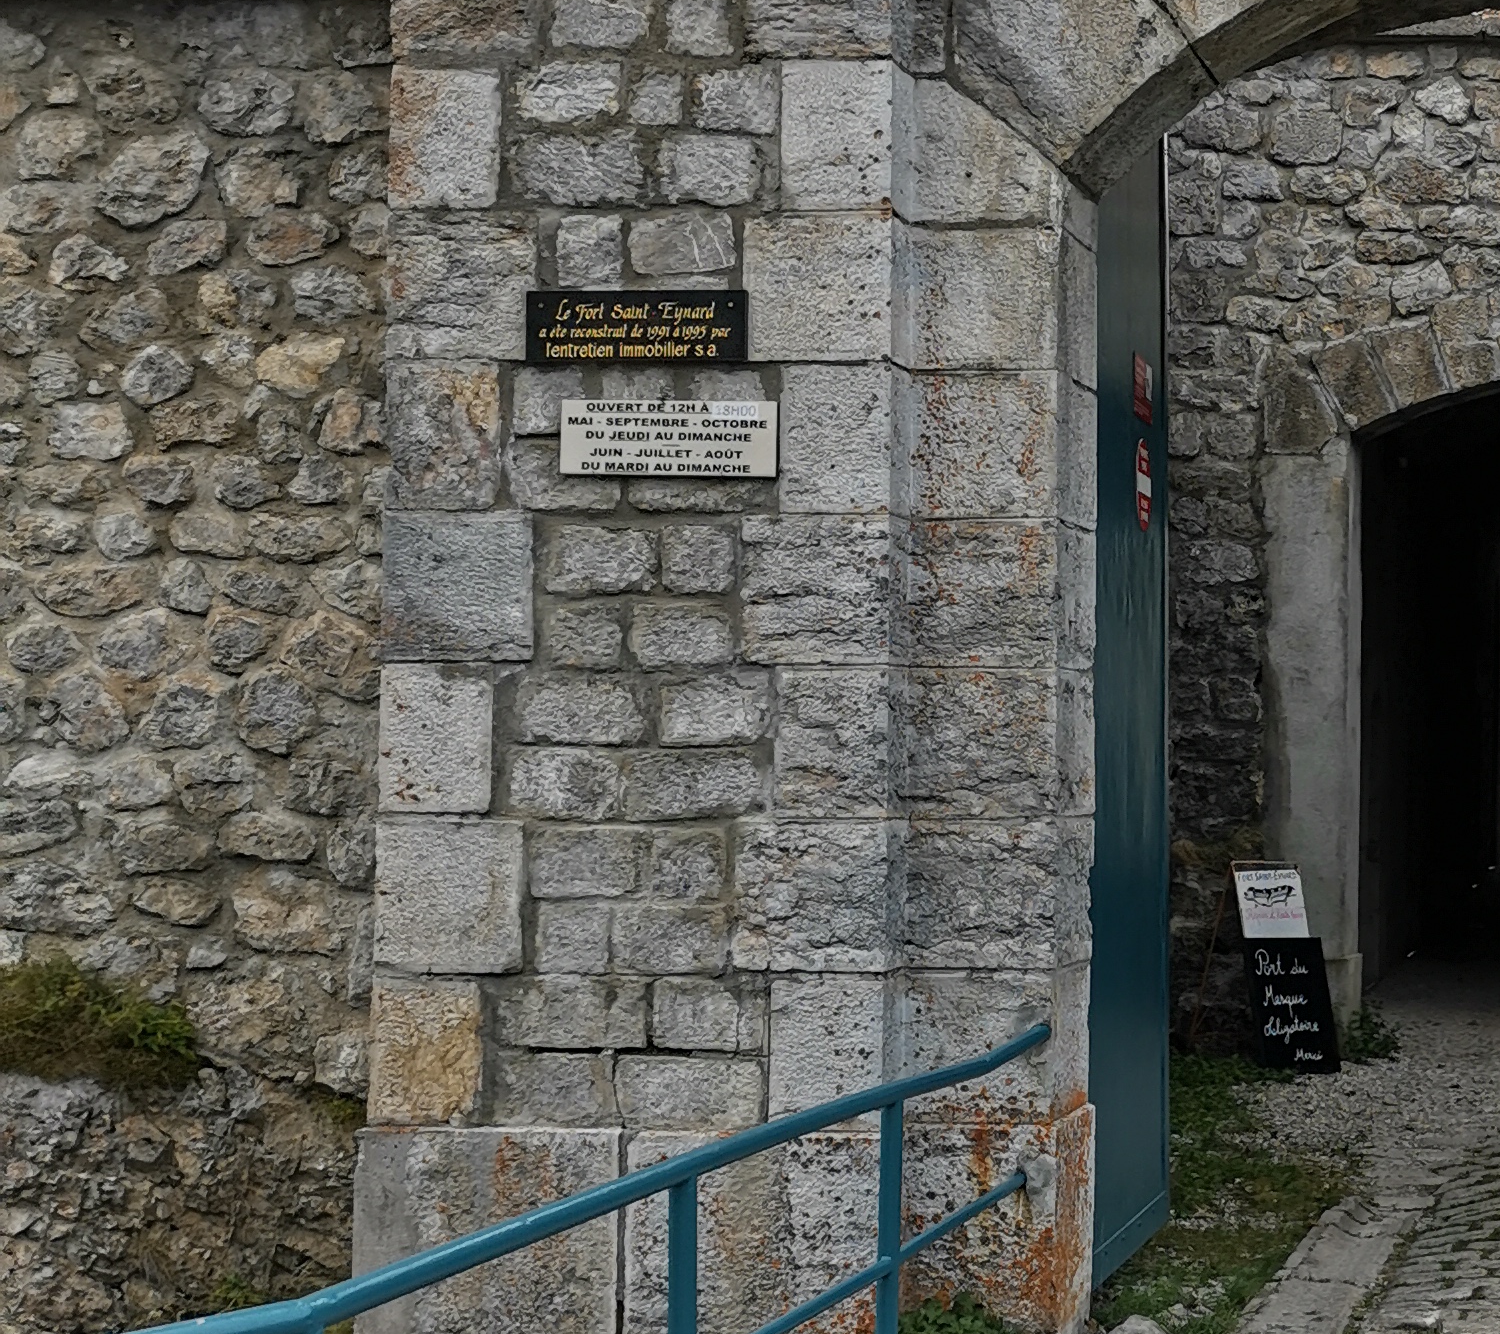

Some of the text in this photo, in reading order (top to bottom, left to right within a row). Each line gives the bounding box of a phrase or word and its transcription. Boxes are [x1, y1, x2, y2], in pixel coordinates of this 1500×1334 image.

[555, 299, 572, 321] Le
[575, 302, 604, 325] Fort
[538, 326, 547, 338] a
[570, 324, 628, 339] reconstruit
[630, 323, 643, 338] de
[647, 326, 670, 341] 1991
[682, 325, 707, 341] 1995
[711, 327, 732, 340] par
[619, 341, 690, 359] immobilier
[586, 402, 643, 413] OUVERT
[648, 402, 665, 413] DE
[671, 402, 696, 413] 12H
[567, 417, 593, 426] MAI
[606, 417, 689, 427] SEPTEMBRE
[701, 419, 768, 429] OCTOBRE
[585, 430, 752, 442] DU JEUDI AU DIMANCHE
[589, 447, 623, 457] JUIN
[634, 448, 693, 458] JUILLET
[704, 447, 743, 459] AOÛT
[581, 461, 751, 473] DU MARDI AU DIMANCHE
[1255, 948, 1309, 976] Port du
[1293, 1048, 1324, 1062] Merci
